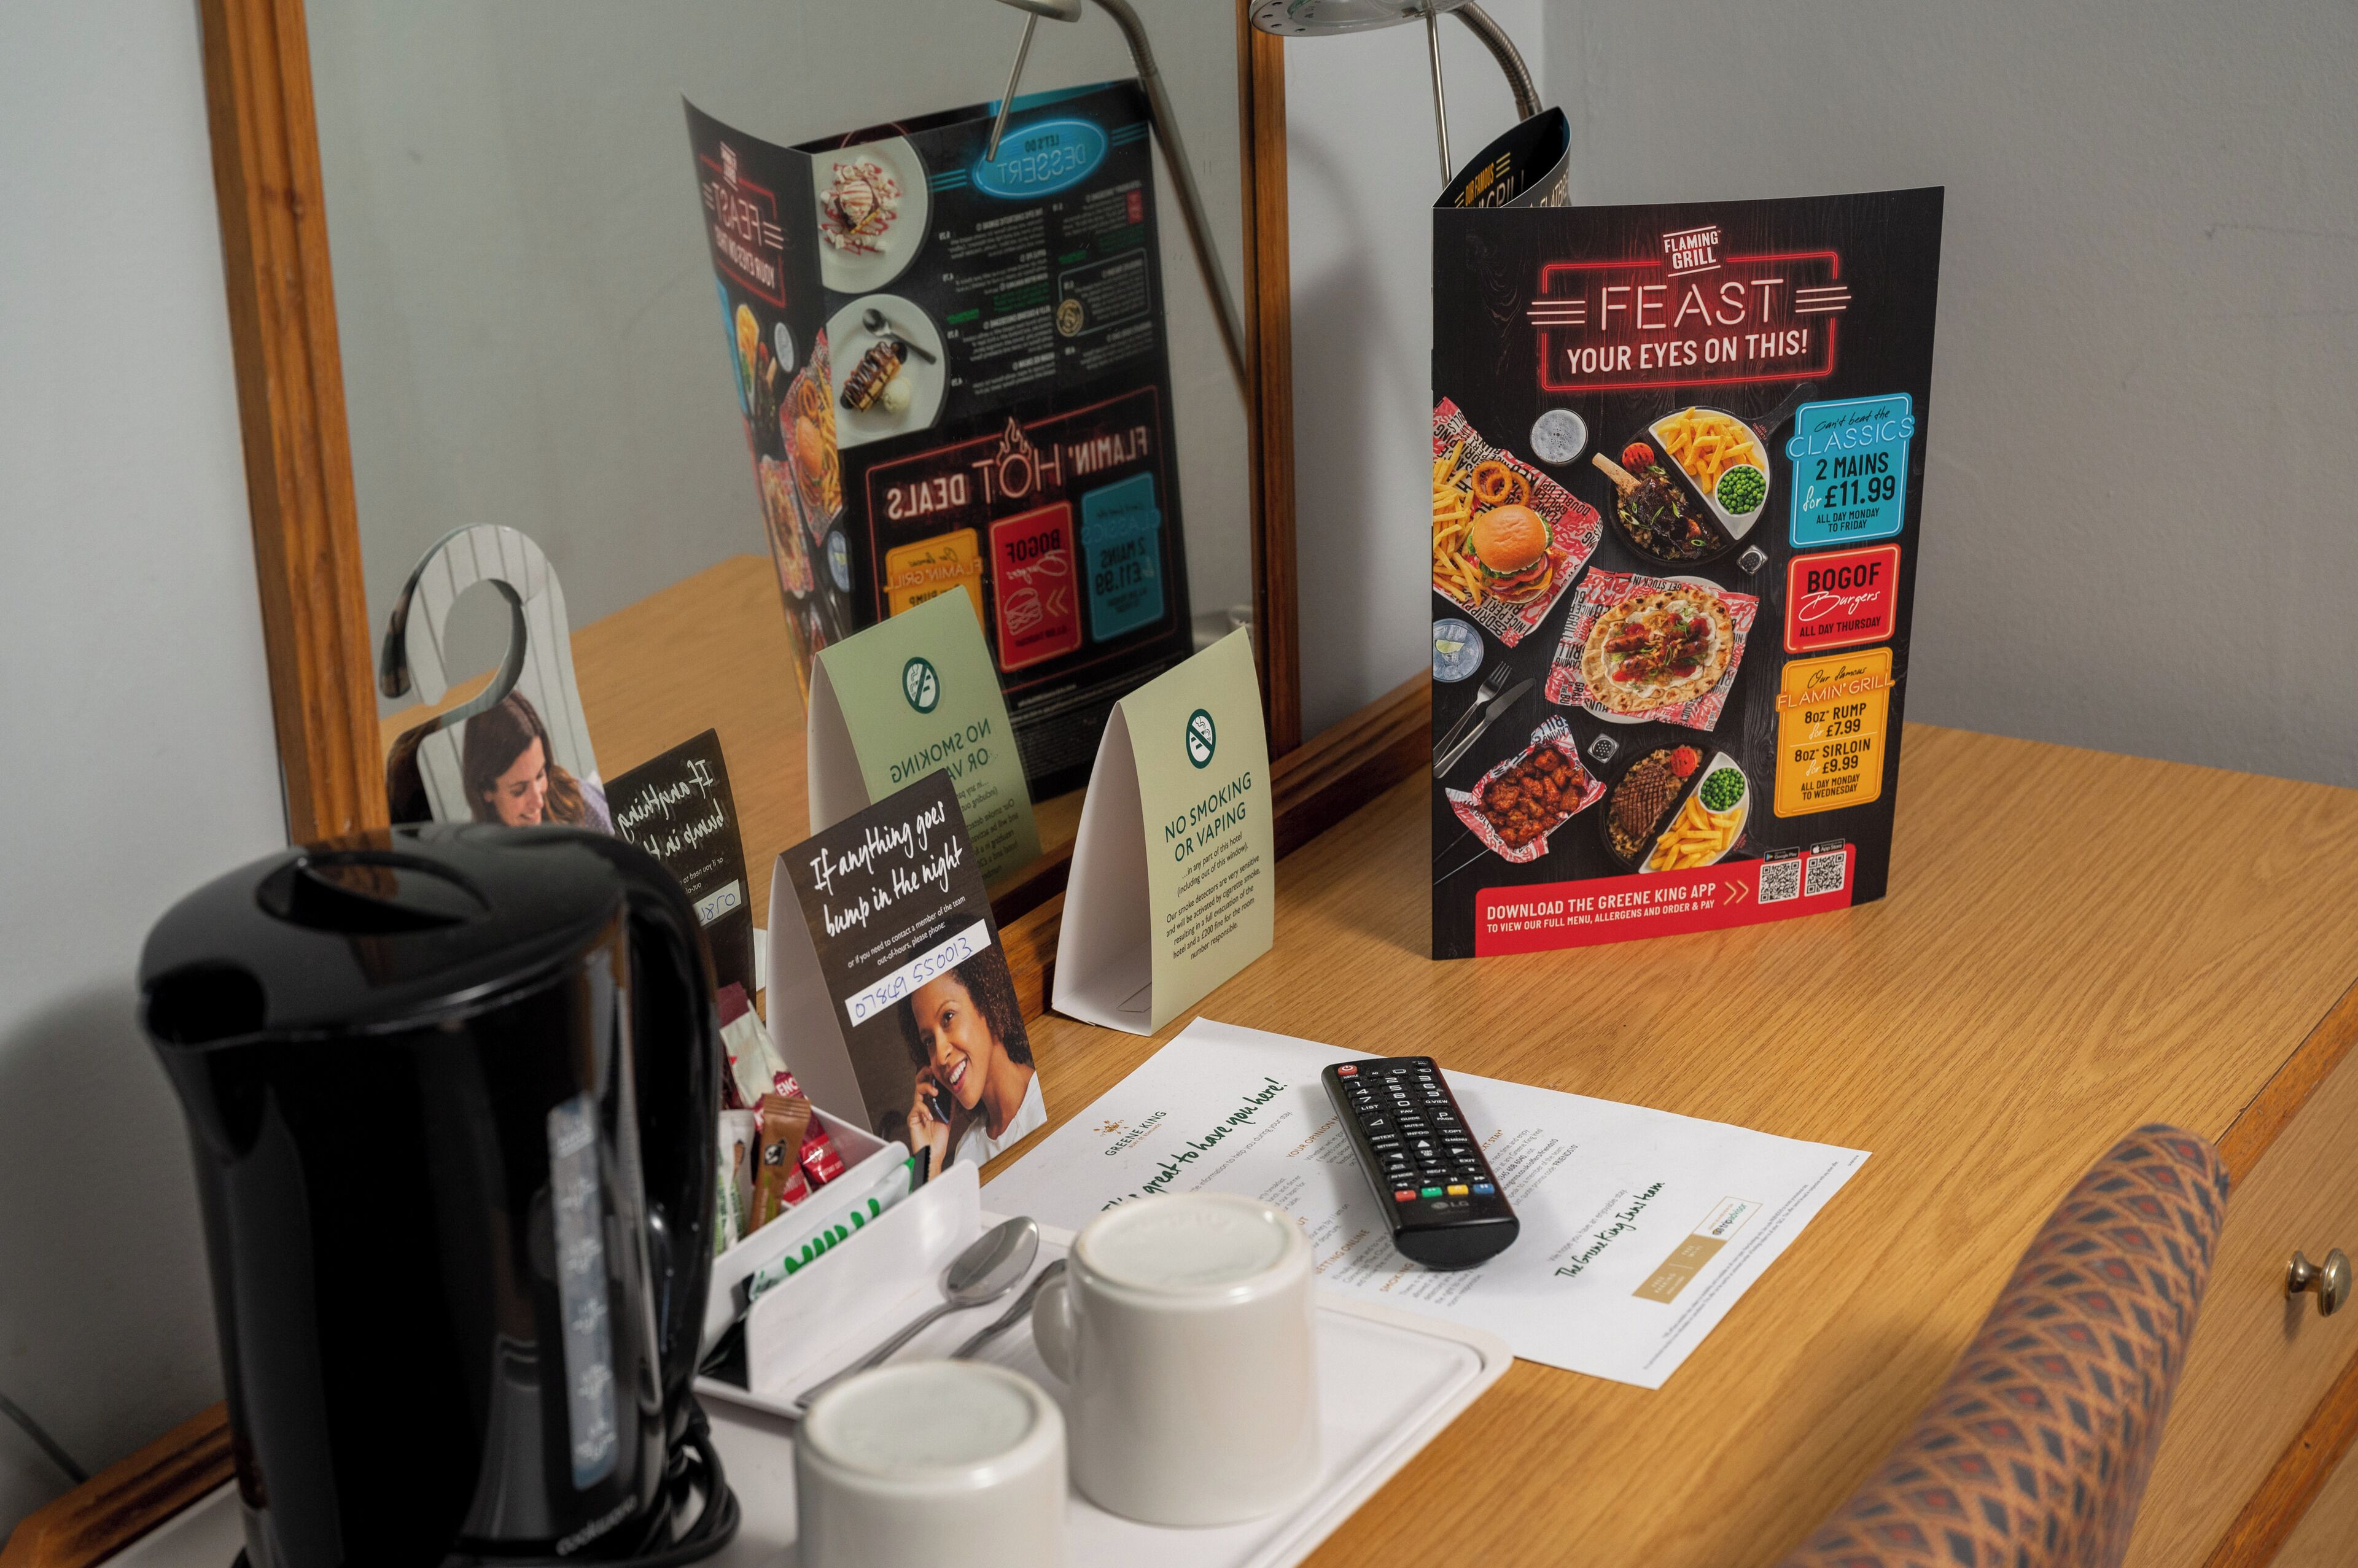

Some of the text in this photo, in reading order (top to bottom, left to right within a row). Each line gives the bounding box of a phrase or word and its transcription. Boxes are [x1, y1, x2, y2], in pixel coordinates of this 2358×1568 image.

[1664, 231, 1718, 253] FLAMING
[1672, 247, 1716, 270] GRILL
[1601, 279, 1783, 330] FEAST
[1567, 329, 1807, 374] YOUR EYES ON THIS!
[1789, 417, 1912, 457] CLASSICS
[1815, 406, 1890, 432] Can't beat the
[1816, 452, 1889, 480] 2 MAINS
[1803, 475, 1896, 511] for £11.99
[1816, 508, 1880, 524] ALL DAY MONDAY
[1829, 519, 1867, 532] TO FRIDAY
[1808, 562, 1881, 593] BOGOF
[1799, 591, 1880, 621] Burgers
[1799, 616, 1881, 637] ALL DAY THURSDAY
[1778, 676, 1893, 710] FLAMIN' GRILL
[1808, 666, 1867, 688] Our famous
[1809, 718, 1860, 740] for £7.99
[1833, 702, 1866, 720] RUMP
[1806, 755, 1858, 776] for £9.99
[1823, 738, 1871, 758] SIRLOIN
[1801, 774, 1860, 791] ALL DAY MONDAY
[1814, 784, 1857, 799] WEDNESDAY
[1165, 772, 1251, 843] NO SMOKING
[810, 801, 945, 896] If anything goes
[1175, 802, 1245, 861] OR VAPING
[1178, 875, 1200, 897] (including
[1211, 863, 1216, 872] of
[1227, 842, 1248, 861] window).
[1182, 867, 1192, 879] ...in
[1203, 854, 1213, 867] part
[1214, 847, 1220, 856] of
[1230, 831, 1242, 847] hotel
[823, 835, 962, 937] bump in the night
[1167, 910, 1177, 923] Our
[1178, 901, 1194, 915] smoke
[1196, 885, 1218, 904] detectors
[1228, 871, 1238, 881] very
[1240, 855, 1259, 873] sensitive
[1167, 926, 1175, 937] and
[1177, 918, 1185, 928] will
[1194, 900, 1215, 917] activated
[1216, 895, 1221, 904] by
[1223, 880, 1243, 898] cigarette
[1244, 868, 1260, 883] smoke,
[1487, 883, 1716, 920] DOWNLOAD THE GREENE KING APP
[855, 955, 859, 964] if
[860, 953, 870, 963] you
[871, 942, 884, 955] need
[892, 928, 911, 943] contact
[916, 913, 936, 928] member
[938, 907, 943, 915] of
[944, 903, 952, 912] the
[952, 896, 965, 907] team
[1173, 944, 1186, 959] hotel
[1187, 938, 1196, 950] and
[1201, 925, 1213, 939] £200
[1214, 919, 1223, 930] fine
[1242, 898, 1254, 911] room
[1174, 926, 1194, 945] resulting
[1214, 896, 1239, 917] evacuation
[1240, 888, 1245, 898] of
[1487, 923, 1498, 933] TO
[1500, 922, 1522, 932] VIEW
[1524, 920, 1541, 930] OUR
[1544, 917, 1565, 928] FULL
[1567, 914, 1593, 926] MENU,
[1595, 909, 1642, 922] ALLERGENS
[1644, 906, 1660, 916] AND
[1663, 903, 1689, 914] ORDER
[1700, 899, 1714, 909] PAY
[877, 922, 946, 965] out-of-hours, please phone:
[1191, 922, 1238, 960] number responsible.
[855, 937, 973, 1017] 07849 550013
[1105, 1111, 1167, 1156] GREENE KING
[1143, 1077, 1288, 1194] great to have you here!
[1554, 1265, 1584, 1278] The
[1594, 1222, 1636, 1241] King
[1633, 1182, 1665, 1200] team
